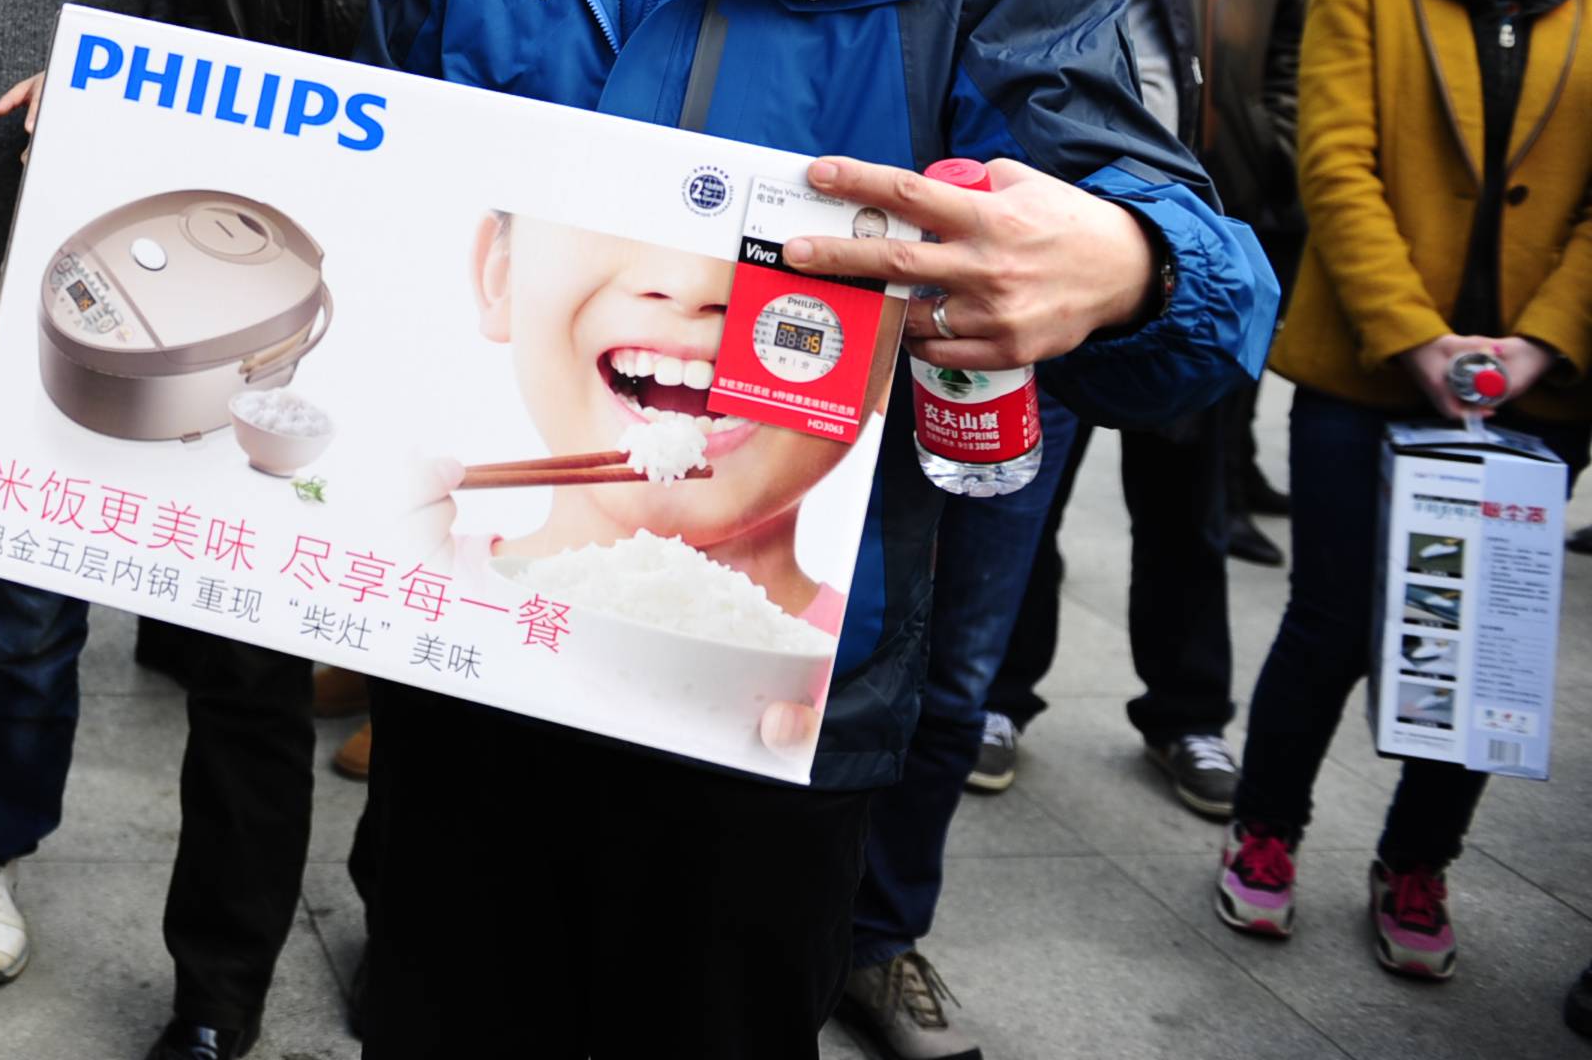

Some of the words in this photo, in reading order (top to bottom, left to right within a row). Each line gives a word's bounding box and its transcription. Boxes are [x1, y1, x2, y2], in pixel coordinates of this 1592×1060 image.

[70, 33, 386, 151] PHILIPS
[759, 183, 783, 195] Philips
[785, 188, 801, 199] Viva
[803, 192, 845, 206] Collection
[746, 242, 777, 264] Viva
[788, 297, 824, 311] PHILIPS
[807, 418, 845, 435] HD3065
[924, 401, 999, 430] 农夫山泉
[962, 430, 999, 440] SPRING
[280, 535, 572, 653] 尽享每一餐
[191, 575, 263, 624] 重现
[409, 632, 483, 679] 美味
